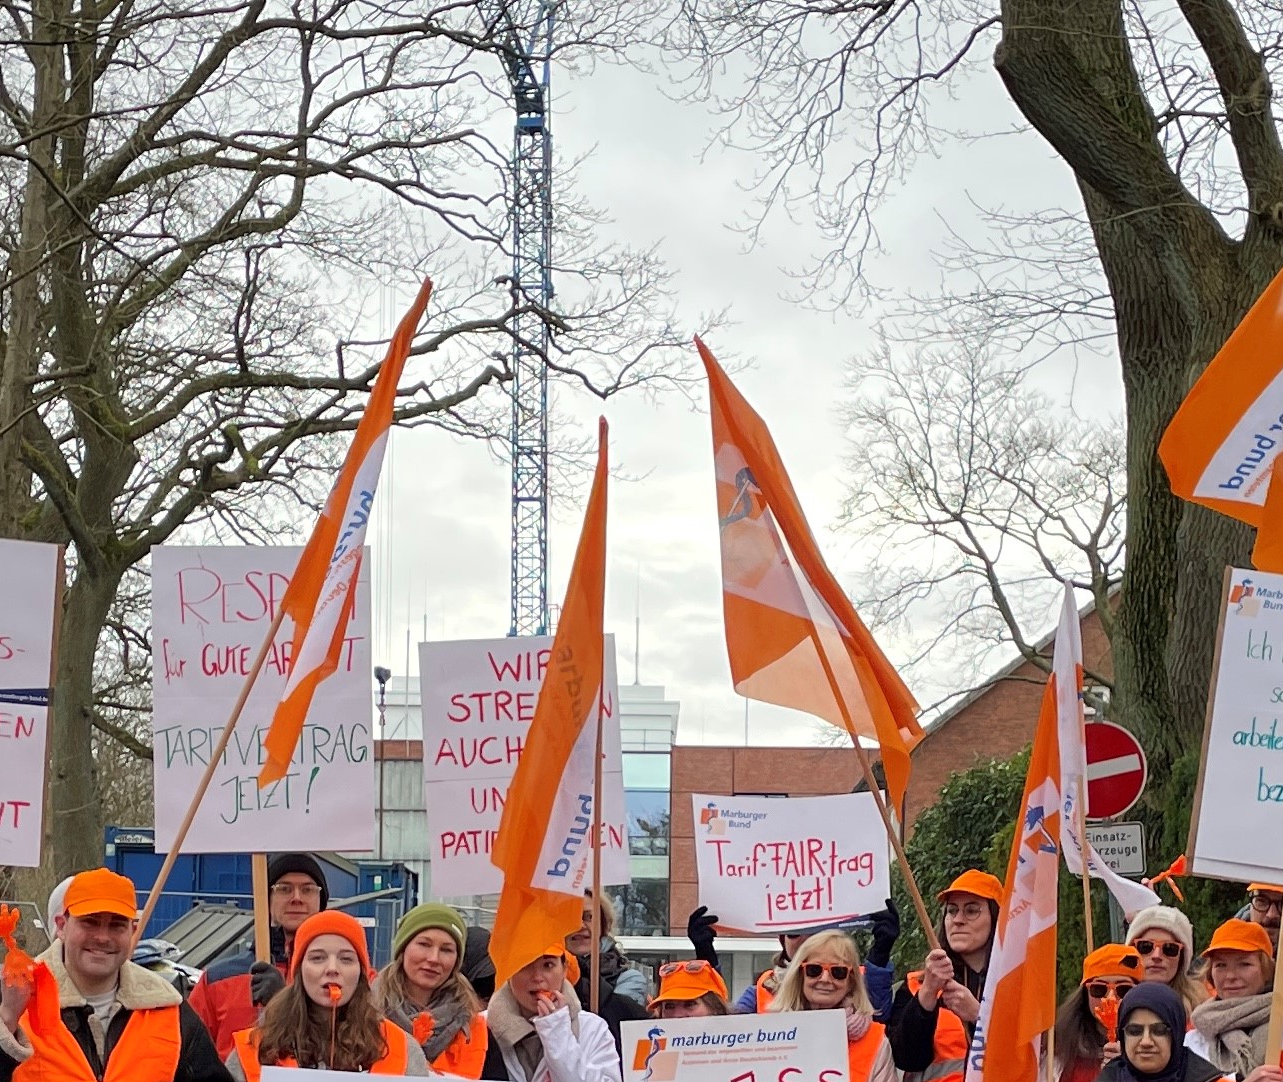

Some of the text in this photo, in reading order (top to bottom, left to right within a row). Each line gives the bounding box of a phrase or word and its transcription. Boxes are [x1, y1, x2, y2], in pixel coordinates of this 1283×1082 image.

[202, 643, 251, 676] GUTE
[265, 636, 365, 685] ART
[1247, 629, 1273, 661] Ich
[447, 690, 613, 722] STREN
[155, 723, 368, 769] TARIFVETRAG
[720, 809, 768, 821] Marburger
[728, 820, 752, 829] Bund
[706, 838, 874, 887] Tarif-FAIR-trag
[765, 877, 834, 921] jetzt!
[671, 1026, 798, 1047] marburger bund
